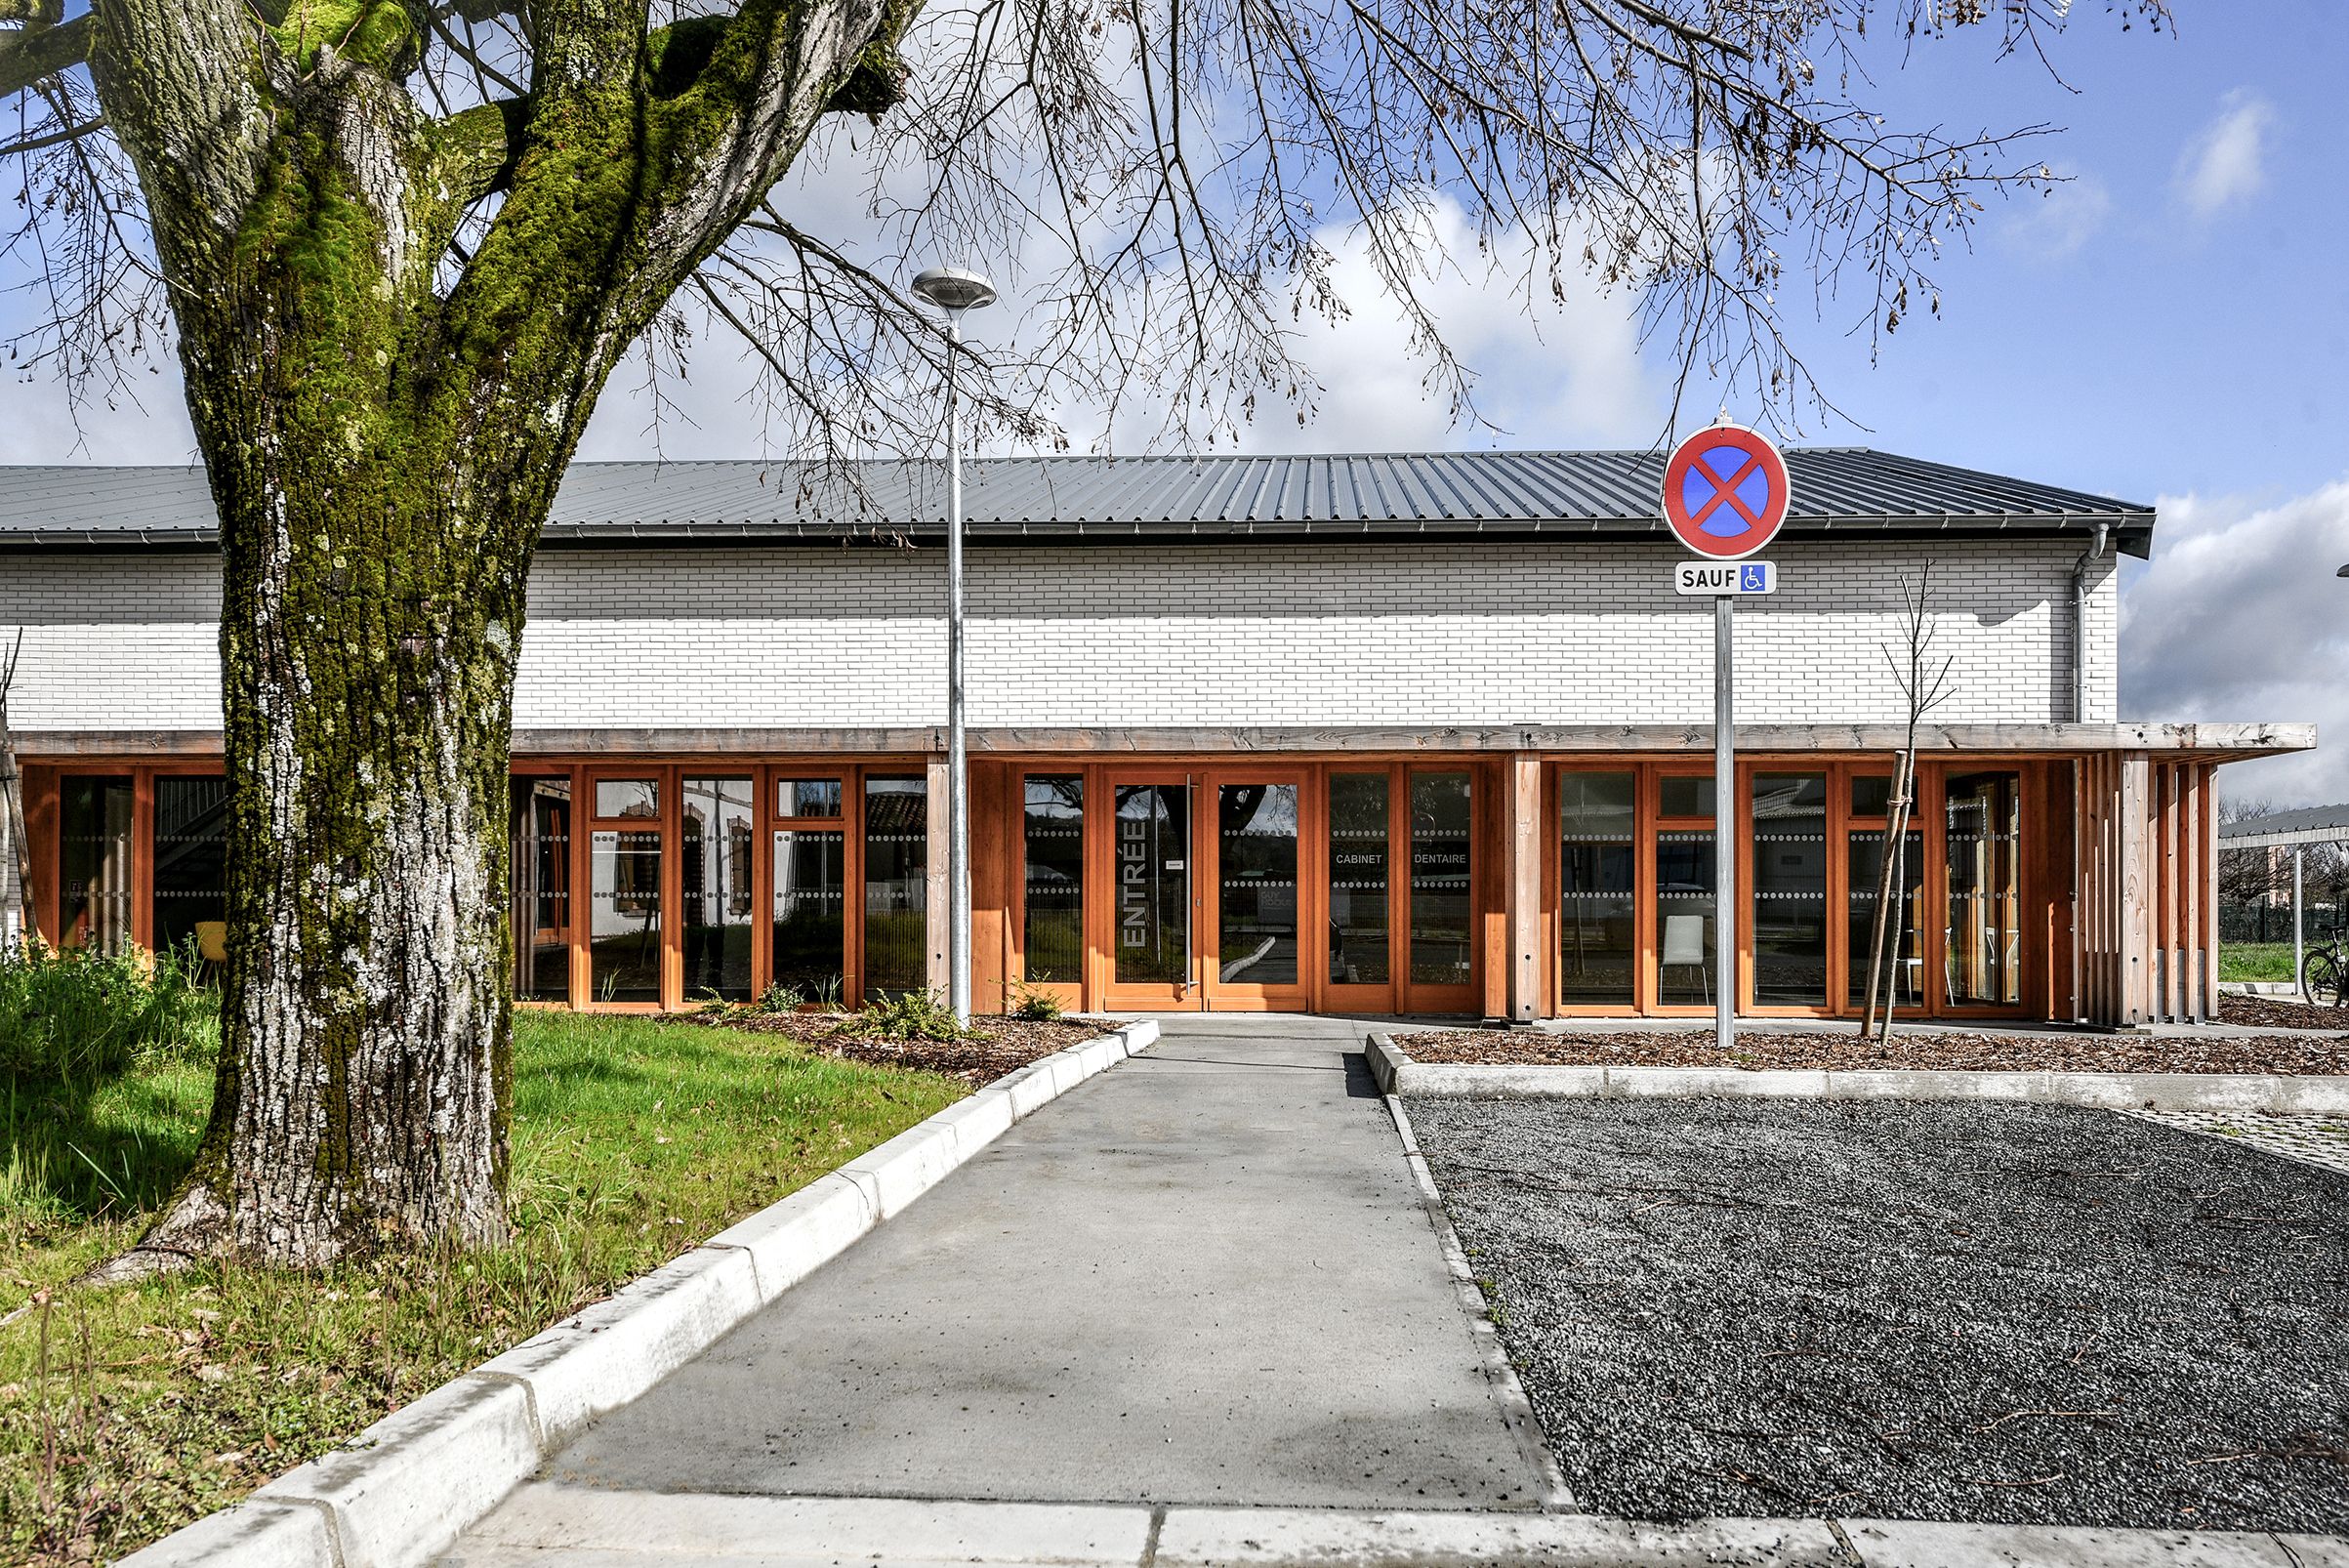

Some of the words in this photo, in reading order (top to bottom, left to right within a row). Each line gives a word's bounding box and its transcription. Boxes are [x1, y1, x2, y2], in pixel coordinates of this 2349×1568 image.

[1681, 569, 1736, 588] SAUF
[1336, 854, 1381, 864] CABINET
[1414, 854, 1466, 864] DENTAIRE
[1117, 821, 1145, 947] ENTRÉE
